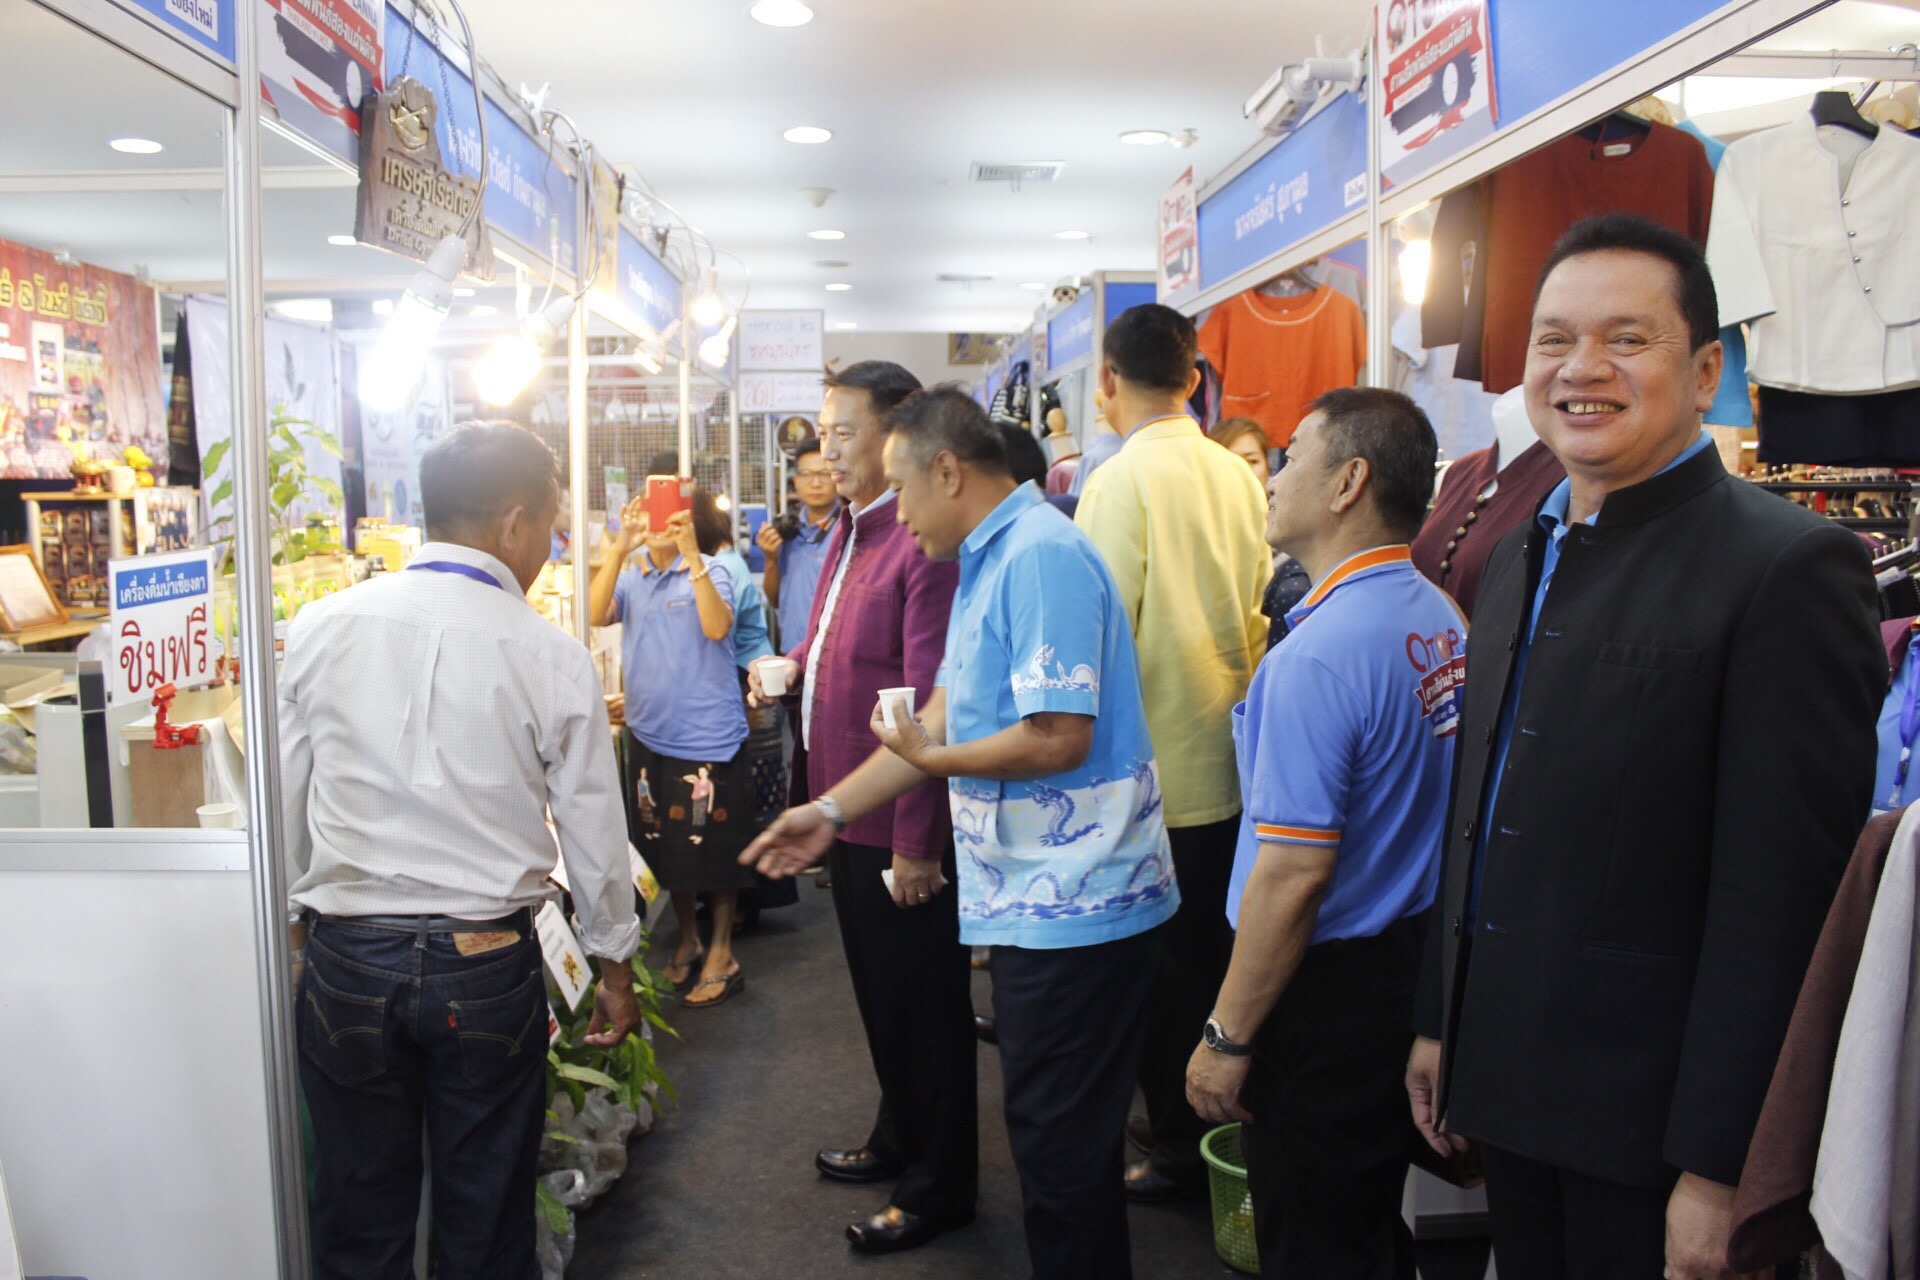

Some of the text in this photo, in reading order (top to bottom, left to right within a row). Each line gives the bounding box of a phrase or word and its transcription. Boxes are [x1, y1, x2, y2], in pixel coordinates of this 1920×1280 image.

[120, 568, 206, 604] เครื่องดื่มน้ำเชียงดา
[120, 602, 207, 693] ชิมฟรี
[1406, 628, 1459, 673] OTOP
